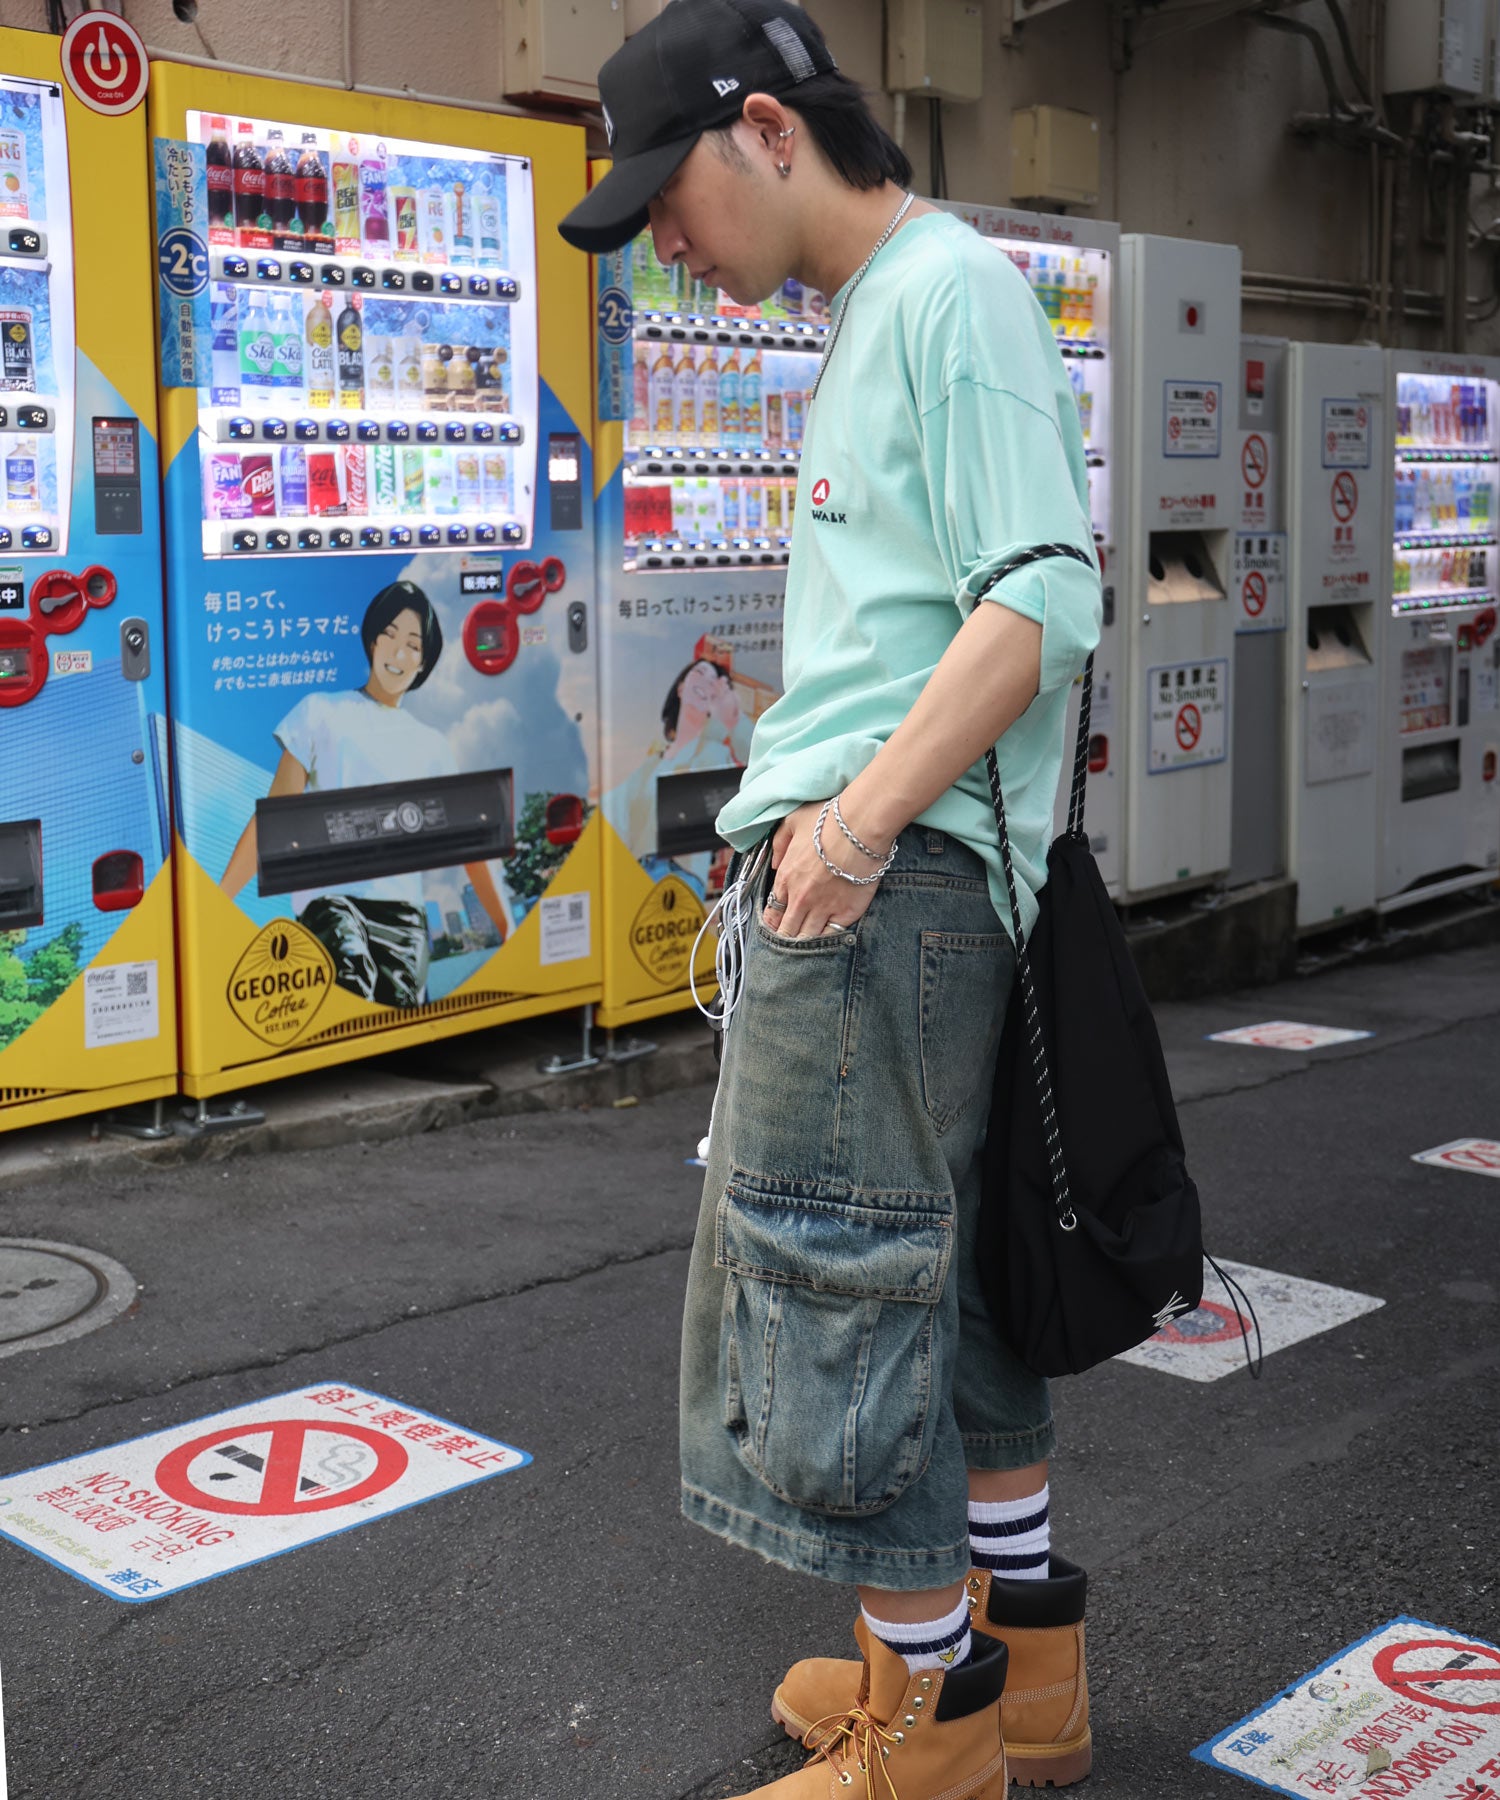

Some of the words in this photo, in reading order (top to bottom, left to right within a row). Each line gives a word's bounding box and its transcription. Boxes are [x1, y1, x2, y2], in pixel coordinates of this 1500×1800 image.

[181, 150, 194, 223] いつもより
[984, 212, 1004, 234] Full
[1008, 217, 1041, 238] lineup
[179, 303, 195, 382] 自動販売機
[811, 509, 847, 525] WALK
[204, 590, 286, 614] 毎日って、
[207, 615, 359, 643] けっこうドラマだ。
[212, 650, 334, 671] #先のことはわからない
[1176, 686, 1217, 702] Smoking
[635, 916, 701, 946] GEORGIA
[234, 965, 326, 1001] GEORGIA
[255, 993, 309, 1025] Coffee
[304, 1388, 506, 1469] 路上喫煙禁止
[34, 1486, 137, 1533] 禁止吸烟
[75, 1472, 131, 1494] NO
[113, 1490, 235, 1546] SMOKING
[130, 1532, 194, 1562] 금연
[105, 1568, 164, 1595] 港区
[1226, 1730, 1274, 1757] 港区
[1434, 1719, 1488, 1746] NO
